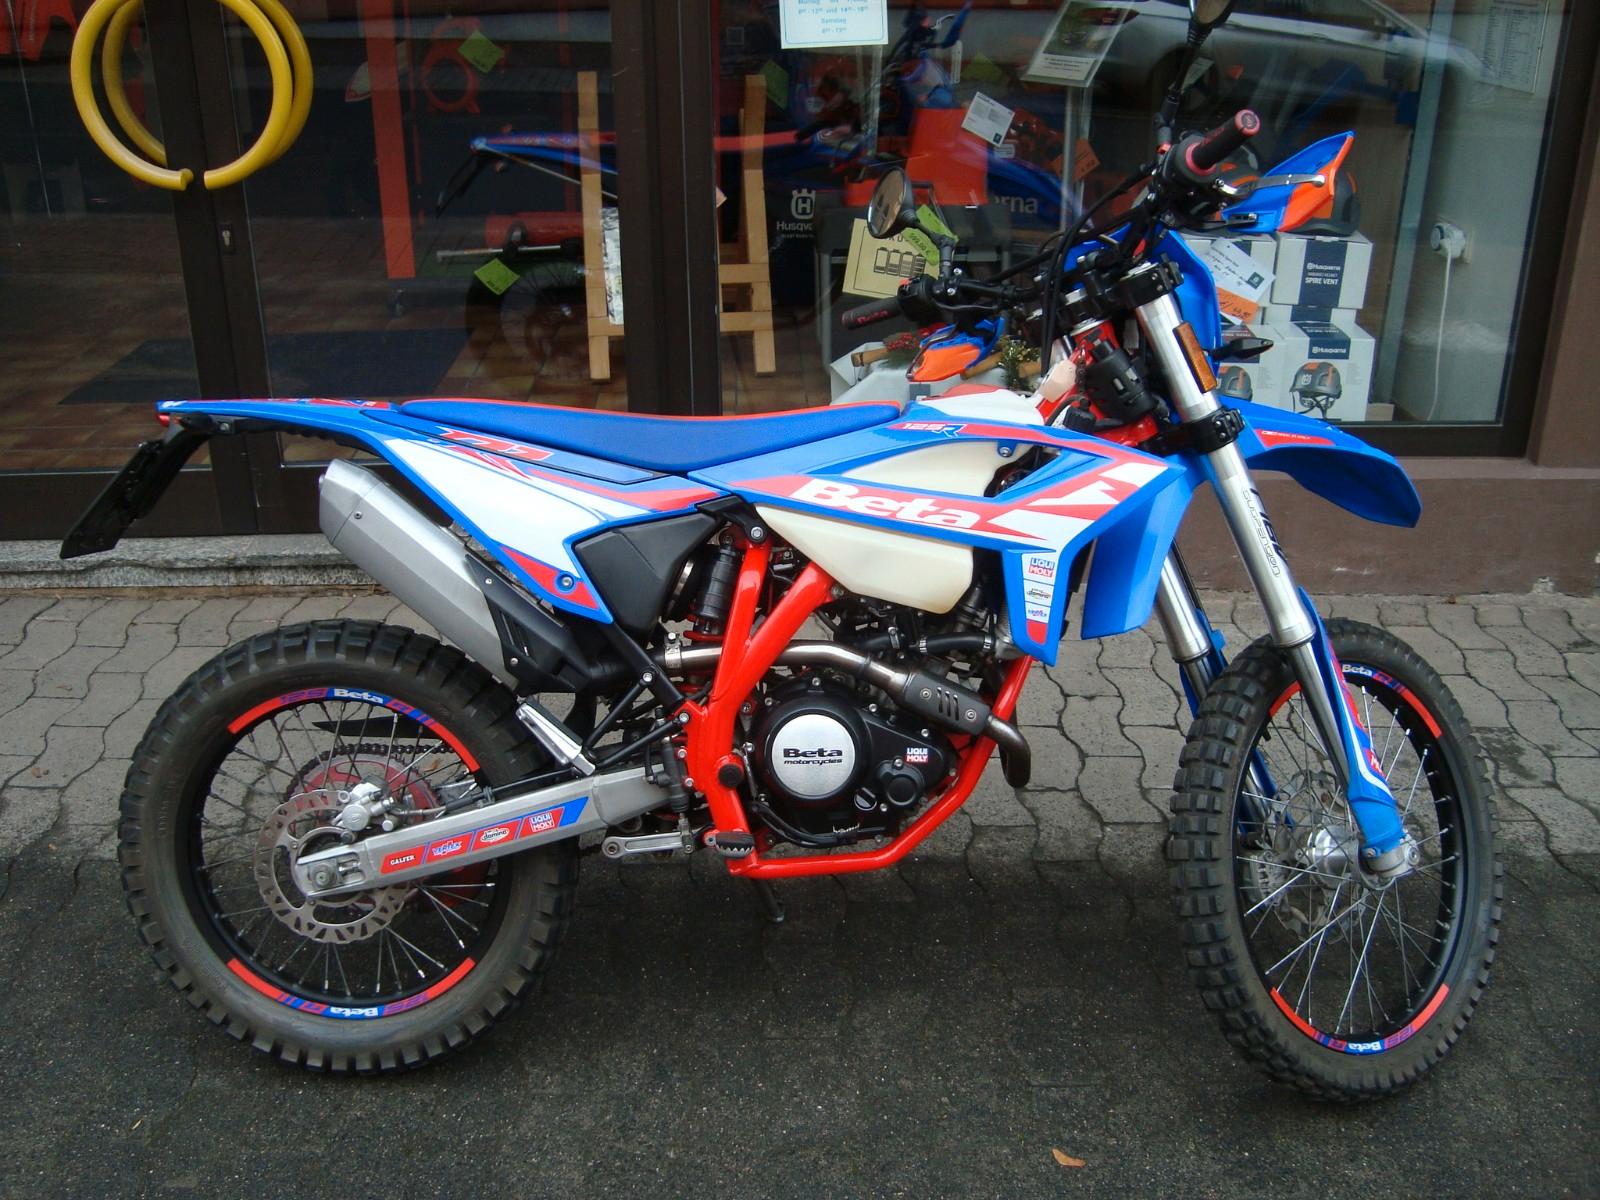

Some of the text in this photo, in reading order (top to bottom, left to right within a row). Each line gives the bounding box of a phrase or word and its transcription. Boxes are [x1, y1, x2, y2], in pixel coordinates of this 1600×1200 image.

[790, 478, 980, 529] Beta
[1030, 557, 1056, 570] LIQUI
[1028, 566, 1054, 578] MOLY
[1342, 663, 1373, 677] Beta
[333, 688, 384, 704] Beta
[783, 747, 843, 758] Beta
[906, 747, 928, 755] LIQUI
[784, 758, 843, 766] motorcycles
[906, 755, 928, 763] MOLY
[530, 812, 552, 825] LIQUI
[531, 819, 555, 832] MOLY
[389, 854, 416, 866] GALFER
[329, 1006, 379, 1017] Beta
[1348, 1041, 1382, 1052] Beta
